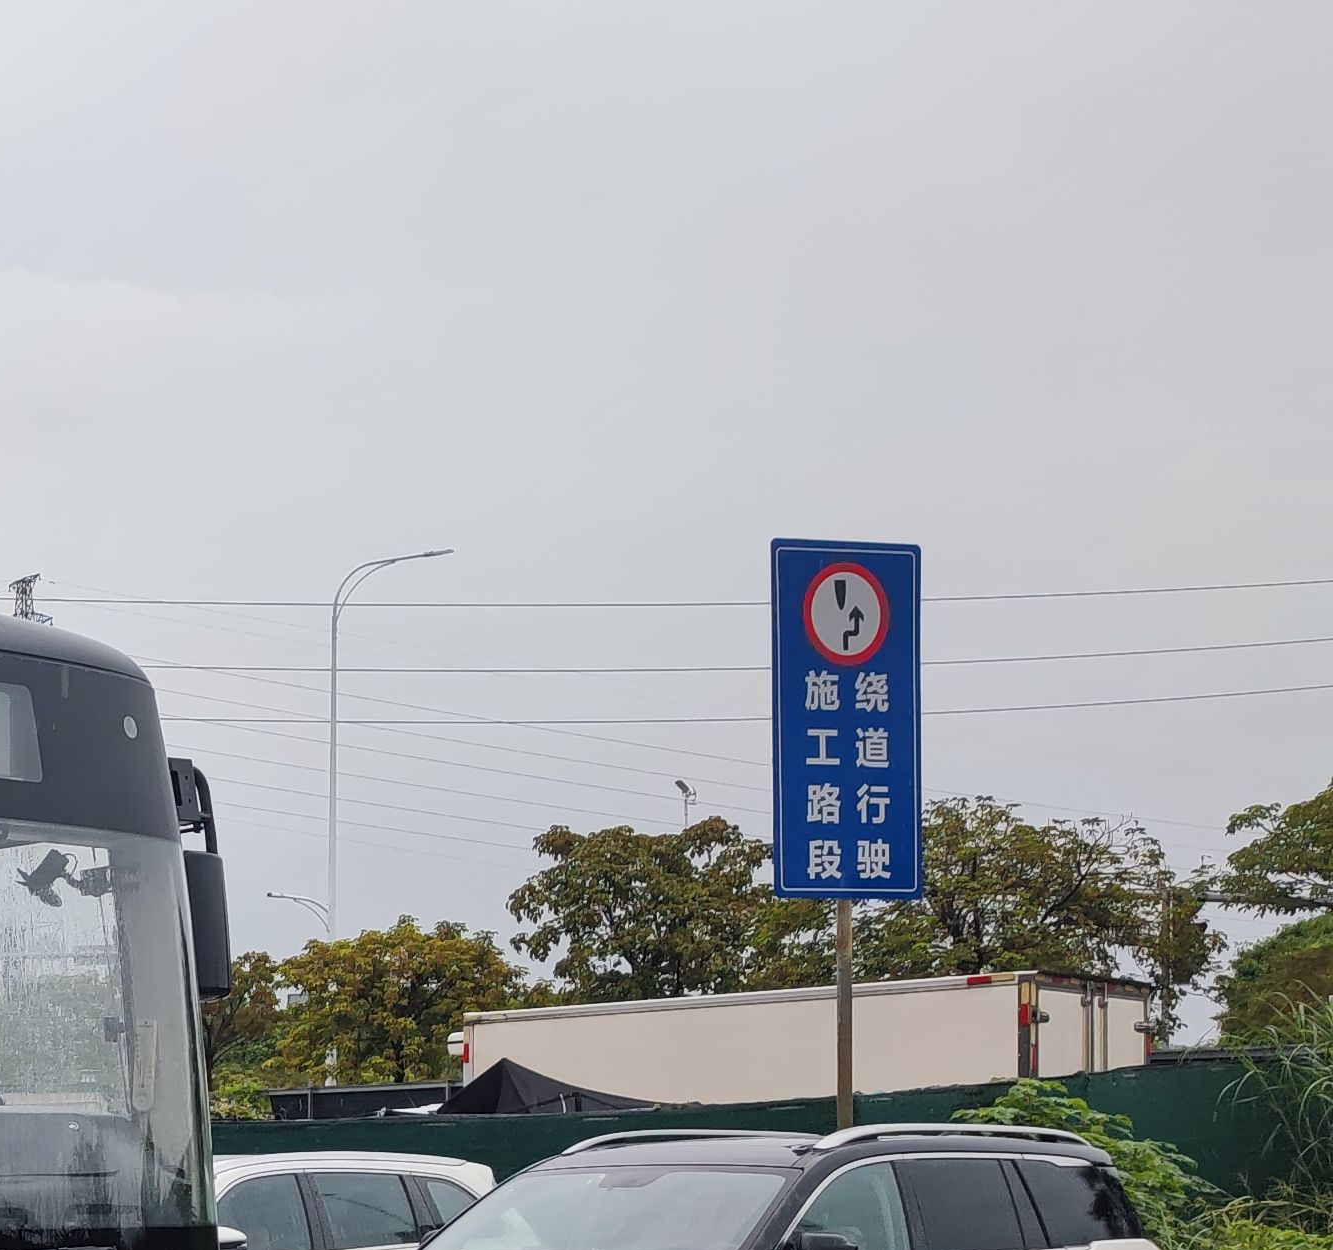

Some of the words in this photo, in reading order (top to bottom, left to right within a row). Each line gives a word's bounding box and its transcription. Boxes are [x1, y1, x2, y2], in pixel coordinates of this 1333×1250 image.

[805, 669, 842, 880] 施工路段
[854, 671, 891, 880] 绕道行驶
